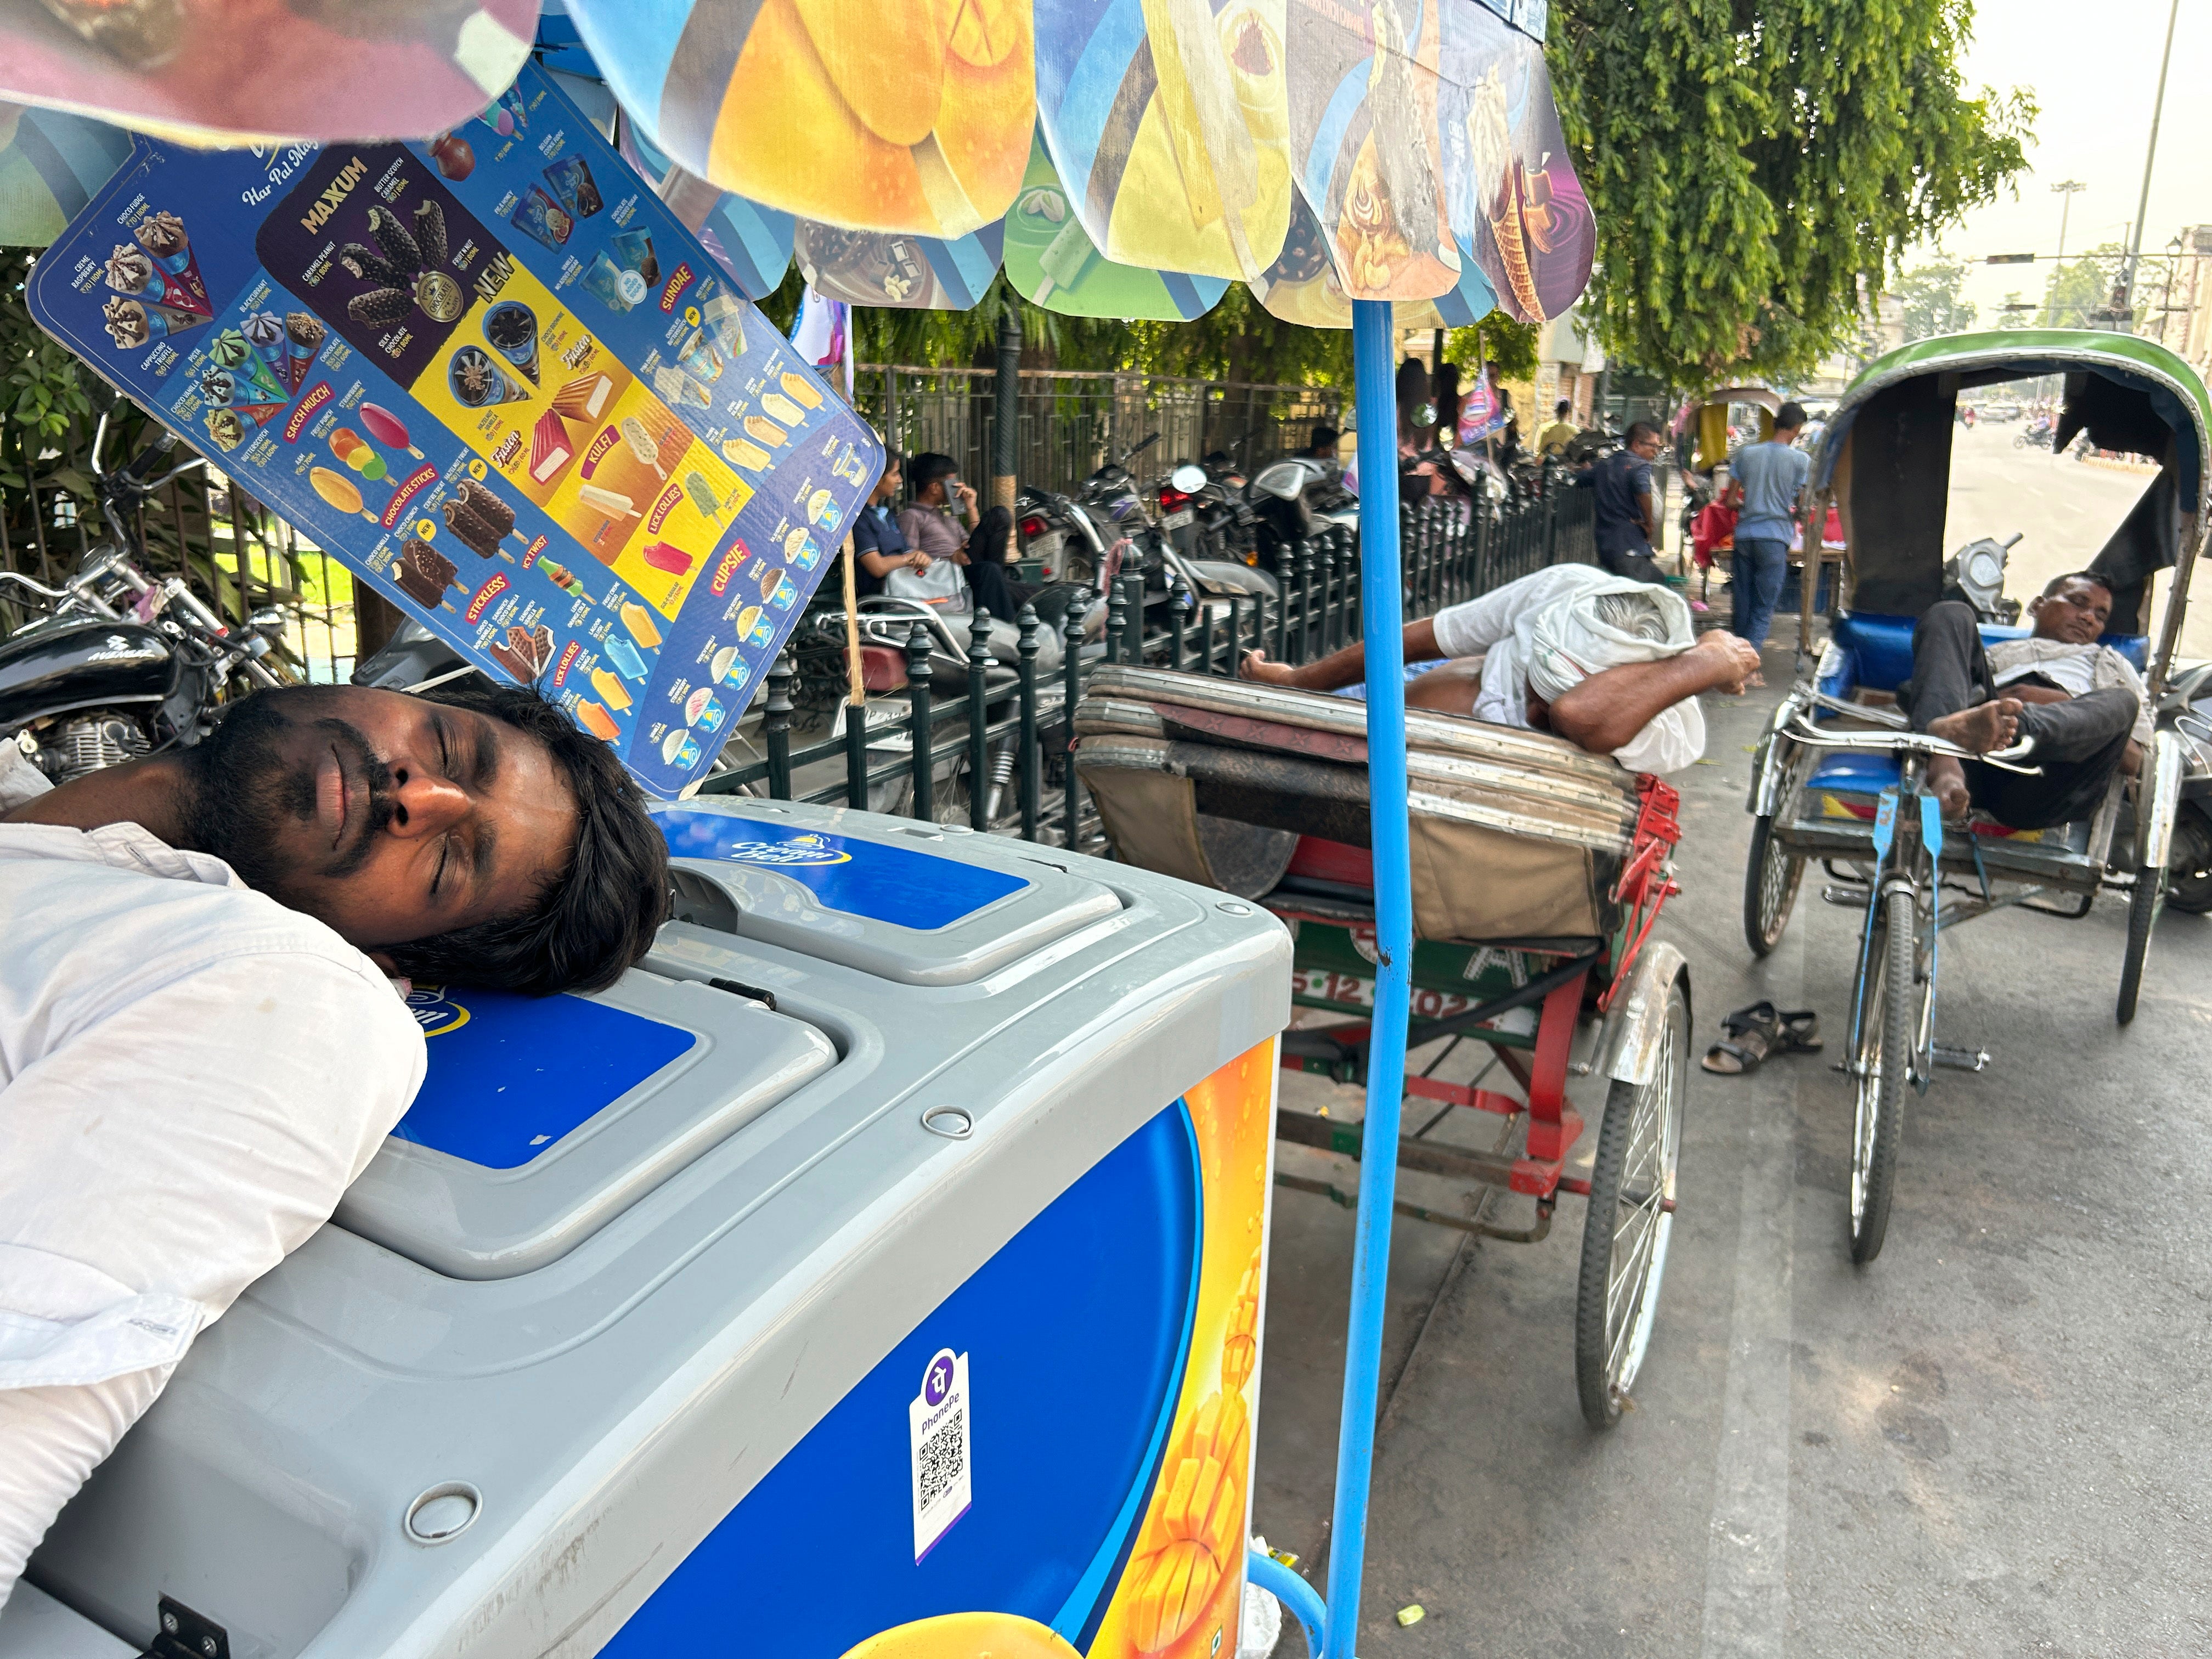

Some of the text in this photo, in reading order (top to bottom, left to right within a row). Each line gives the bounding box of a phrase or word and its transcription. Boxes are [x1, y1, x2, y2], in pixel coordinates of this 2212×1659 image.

[242, 184, 270, 205] Har
[269, 161, 292, 184] Pal
[374, 156, 404, 193] BUTTER SCOTCH
[380, 175, 399, 200] CARAMEL
[116, 193, 145, 225] CHOCO FUDGE
[301, 156, 367, 234] MAXXUM
[74, 254, 91, 273] CREME
[302, 240, 336, 283] CARAMEL PEANUT
[452, 251, 465, 266] FRUIT
[71, 259, 97, 290] RASPBERRY
[472, 250, 516, 304] NEW
[623, 276, 631, 286] NO
[625, 277, 638, 294] ADDED
[663, 266, 690, 309] SUNDAE
[239, 278, 268, 313] BLACKCURRANT
[427, 281, 453, 313] CHOCOLATE
[630, 282, 642, 299] SUGAR
[687, 309, 696, 321] NEW
[188, 347, 201, 363] PISTA
[319, 336, 341, 363] CHOCOLATE
[378, 332, 392, 348] SILKY
[385, 325, 408, 354] CHOCOLATE
[560, 334, 591, 369] Fusion
[140, 340, 166, 371] CAPPUCCINO
[155, 345, 173, 366] TRUFFLE
[170, 378, 200, 414] CHOCO VANILLA
[338, 379, 362, 409] STRAWBERRY
[287, 385, 330, 438] SACCH MUCCH
[311, 408, 334, 437] FRUIT PUNCH
[484, 413, 499, 431] VANILLA
[241, 427, 269, 463] BUTTERSCOTCH
[294, 453, 306, 465] AAM
[458, 446, 470, 461] TREAT
[489, 430, 520, 468] Fusion
[589, 433, 612, 467] KULFI
[472, 462, 483, 475] NEW
[385, 468, 435, 525] CHOCOLATE STICKS
[423, 480, 445, 510] CENTRE TREAT
[647, 487, 680, 531] LICK LOLLIES
[394, 521, 407, 538] CHOCO
[420, 522, 431, 535] NEW
[364, 532, 391, 566] CHOCO VANILLA
[523, 535, 546, 568] ICY TWIST
[714, 544, 746, 591] CUPSIE
[469, 576, 505, 619] STICKLESS
[555, 642, 579, 685] LICK LOLLIES
[731, 842, 834, 859] Cream
[731, 849, 803, 862] Bell
[921, 1392, 960, 1436] PhonePe
